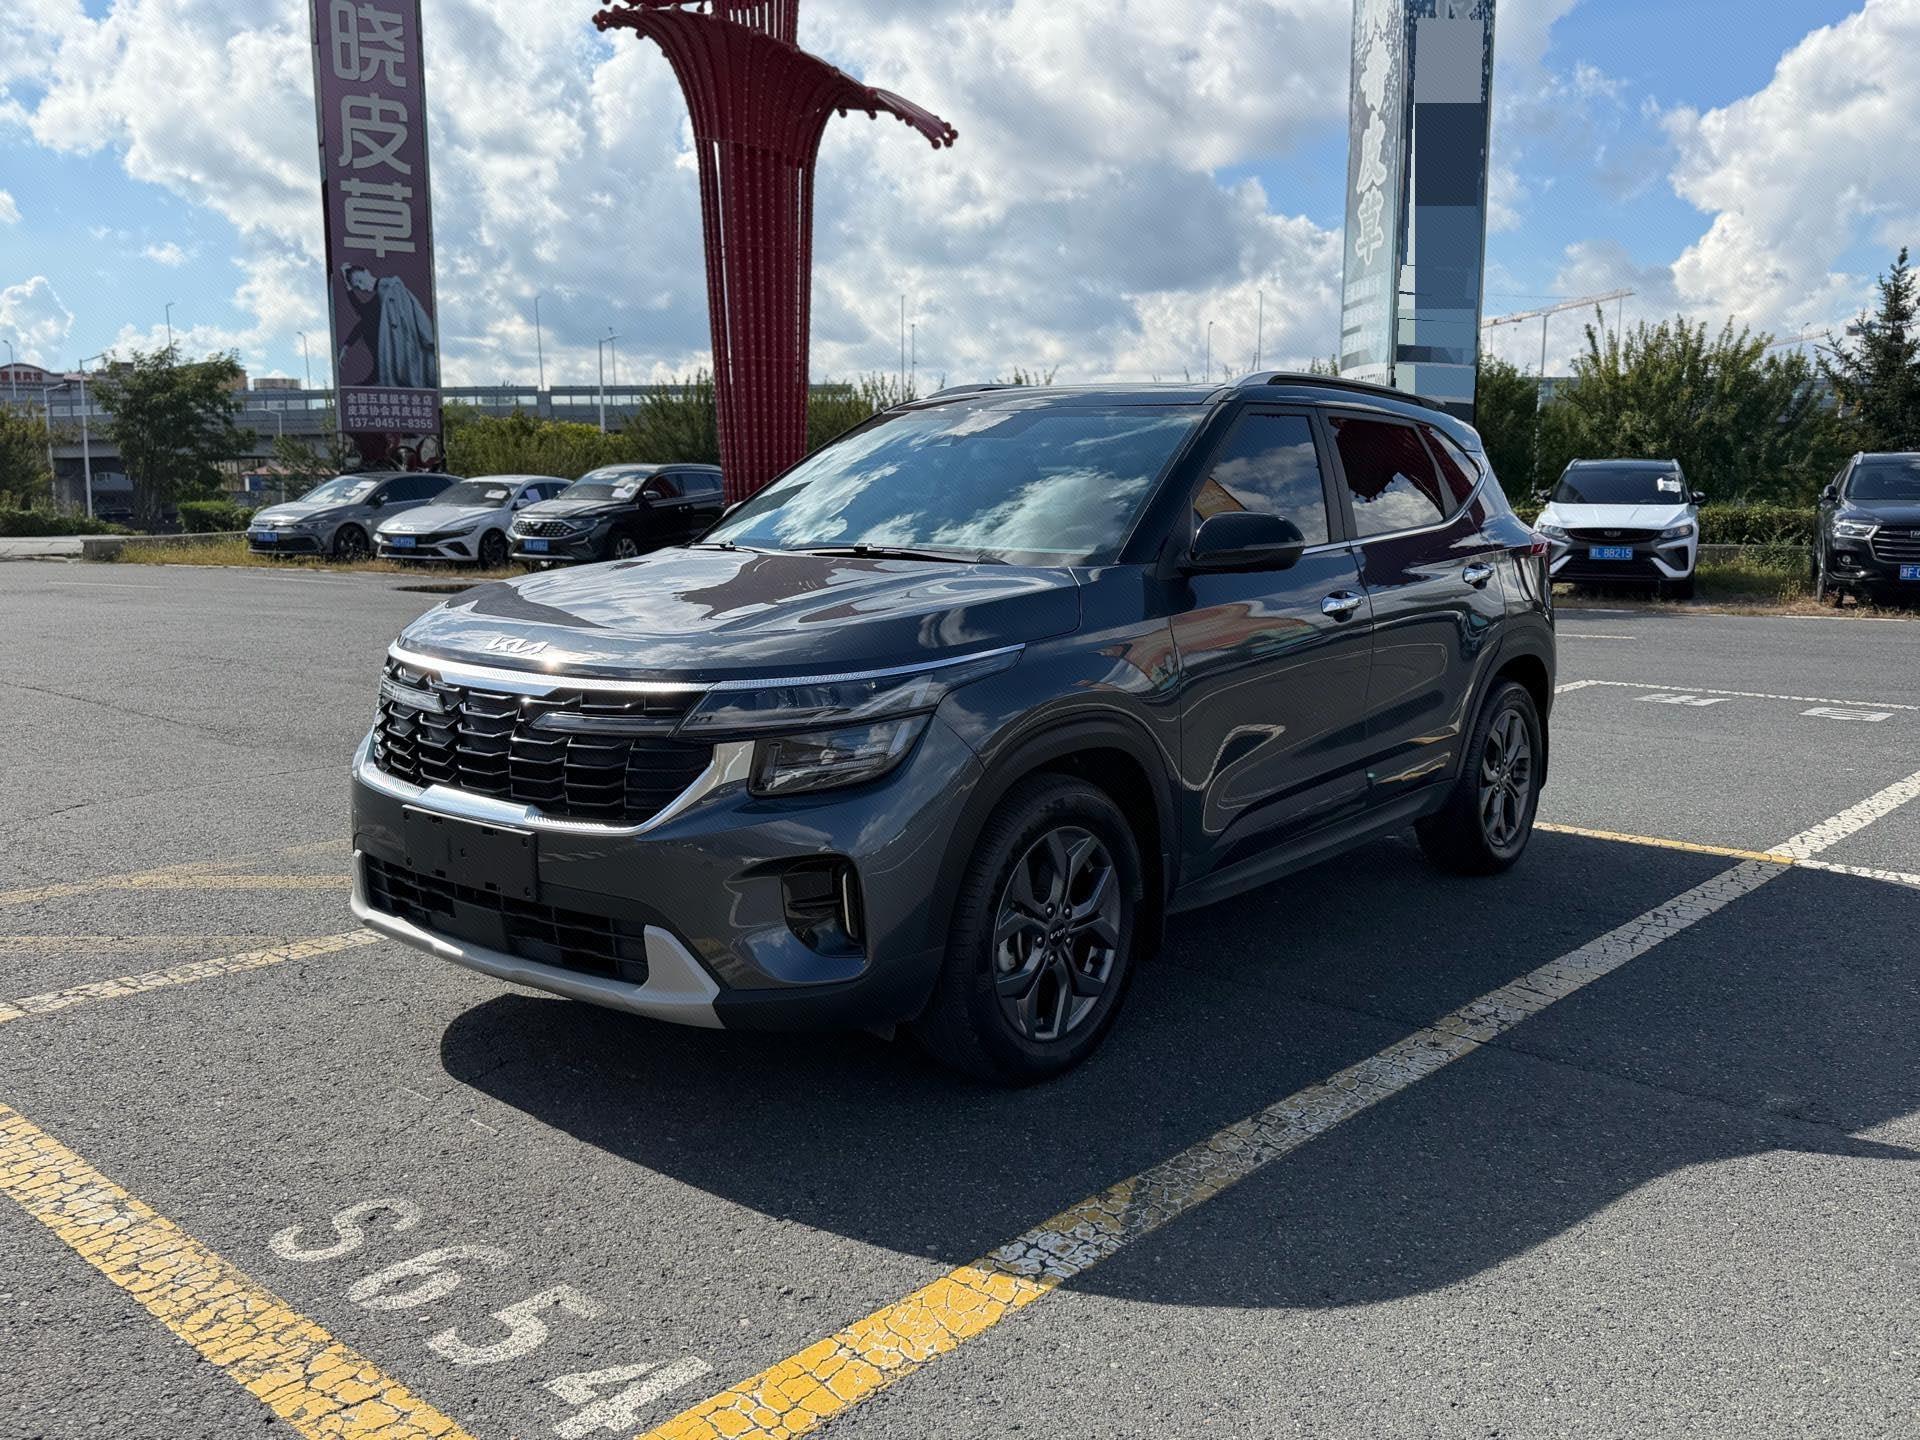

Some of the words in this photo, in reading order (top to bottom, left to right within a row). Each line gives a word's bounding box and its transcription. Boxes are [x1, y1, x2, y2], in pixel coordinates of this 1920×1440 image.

[329, 0, 416, 258] 晓皮草
[347, 393, 432, 406] 全国五星级专业店
[348, 405, 432, 417] 皮革协会真皮标志
[349, 418, 433, 429] 137-0451-8355
[484, 635, 549, 655] KIA
